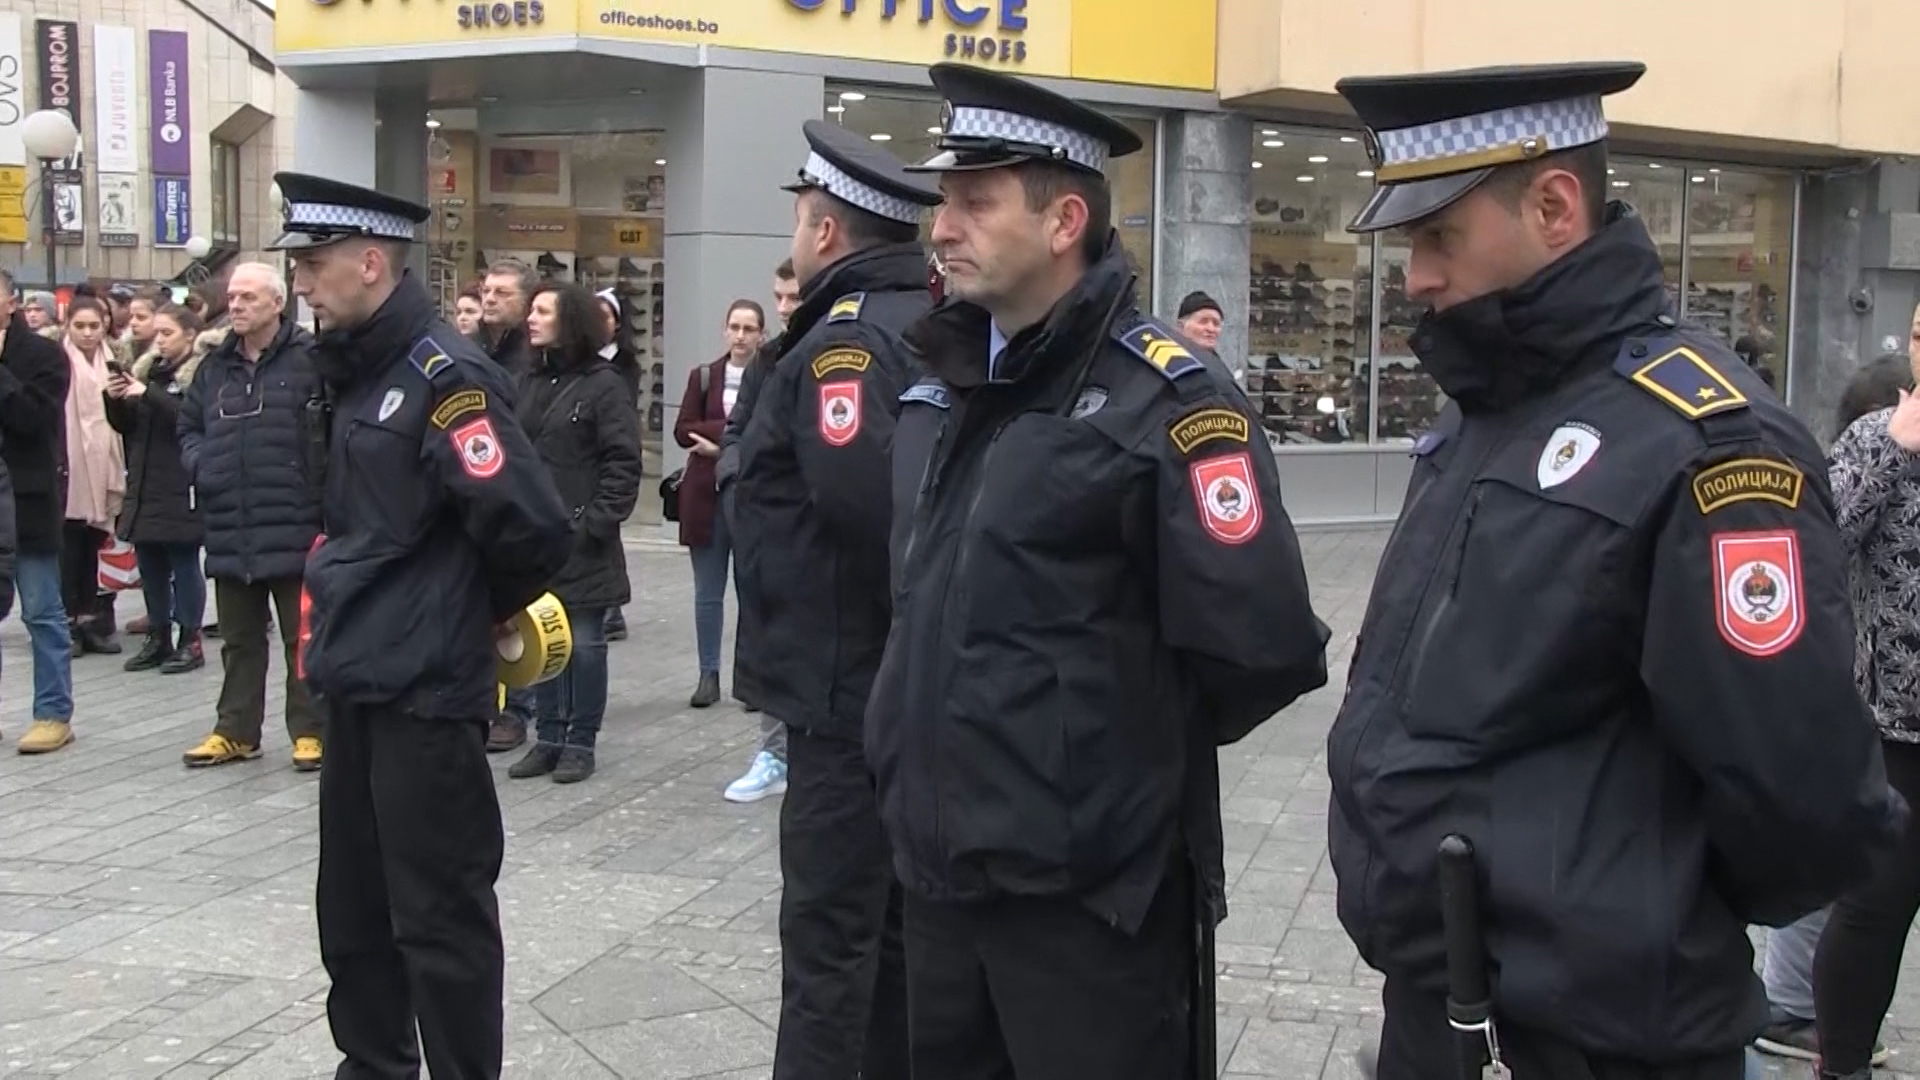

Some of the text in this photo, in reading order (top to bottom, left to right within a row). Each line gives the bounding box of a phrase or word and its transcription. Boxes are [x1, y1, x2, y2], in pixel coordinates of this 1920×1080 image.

[457, 0, 544, 28] SHOES
[600, 10, 718, 34] officeshoes.ba
[945, 33, 1027, 62] SHOES
[48, 25, 70, 106] BOJPROM
[162, 61, 177, 122] NLB Banka
[1180, 417, 1243, 442] ПОЛИЦИЈА
[1703, 471, 1792, 500] ПОЛИЦИЈА
